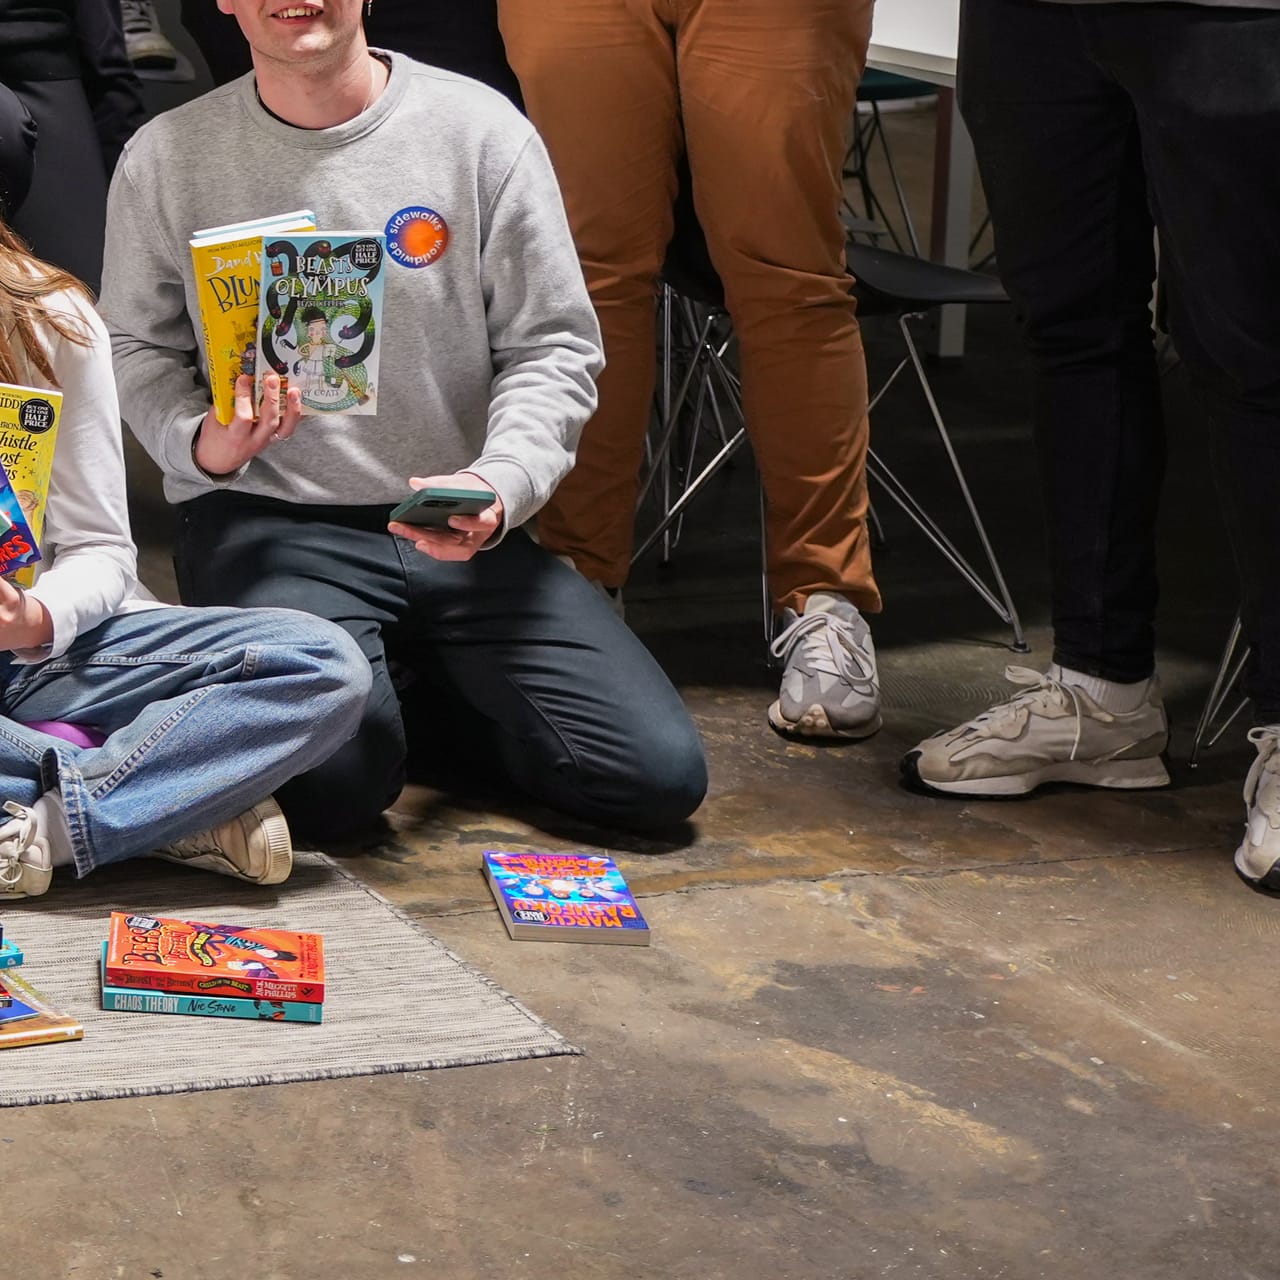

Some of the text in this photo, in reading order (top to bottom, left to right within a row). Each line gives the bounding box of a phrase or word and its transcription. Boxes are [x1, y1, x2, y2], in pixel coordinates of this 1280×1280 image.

[390, 211, 442, 234] sidewalks
[389, 240, 443, 265] worldwide
[295, 256, 354, 275] BEASTS
[274, 277, 370, 300] OLYMPUS
[24, 419, 48, 428] PRICE
[114, 995, 179, 1012] CHAOS THEORY
